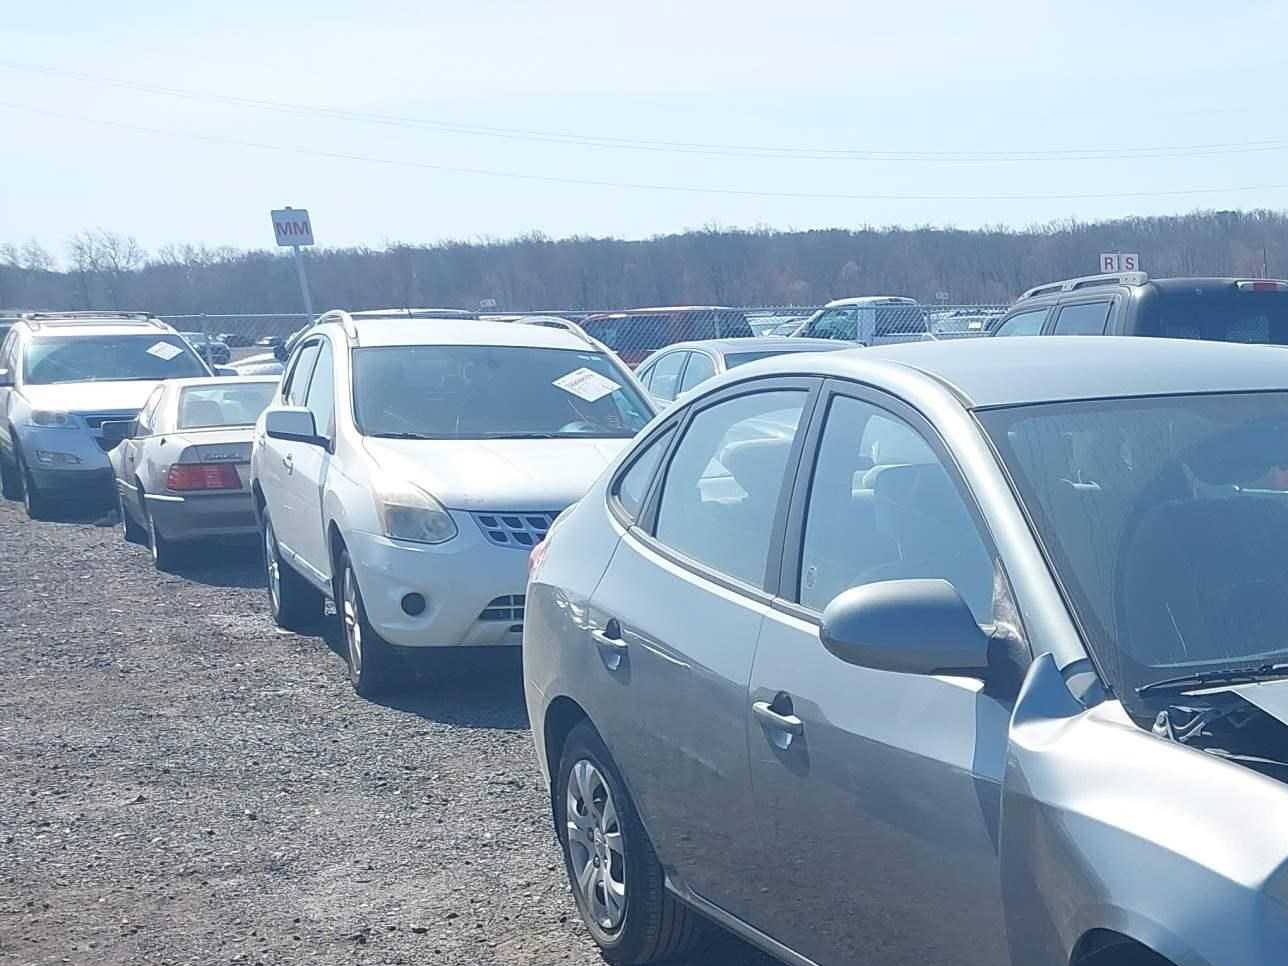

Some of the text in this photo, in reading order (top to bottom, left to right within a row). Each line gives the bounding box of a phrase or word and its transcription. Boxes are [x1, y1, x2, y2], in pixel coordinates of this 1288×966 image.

[276, 221, 310, 236] MM
[1104, 256, 1114, 271] R
[1125, 256, 1135, 271] S
